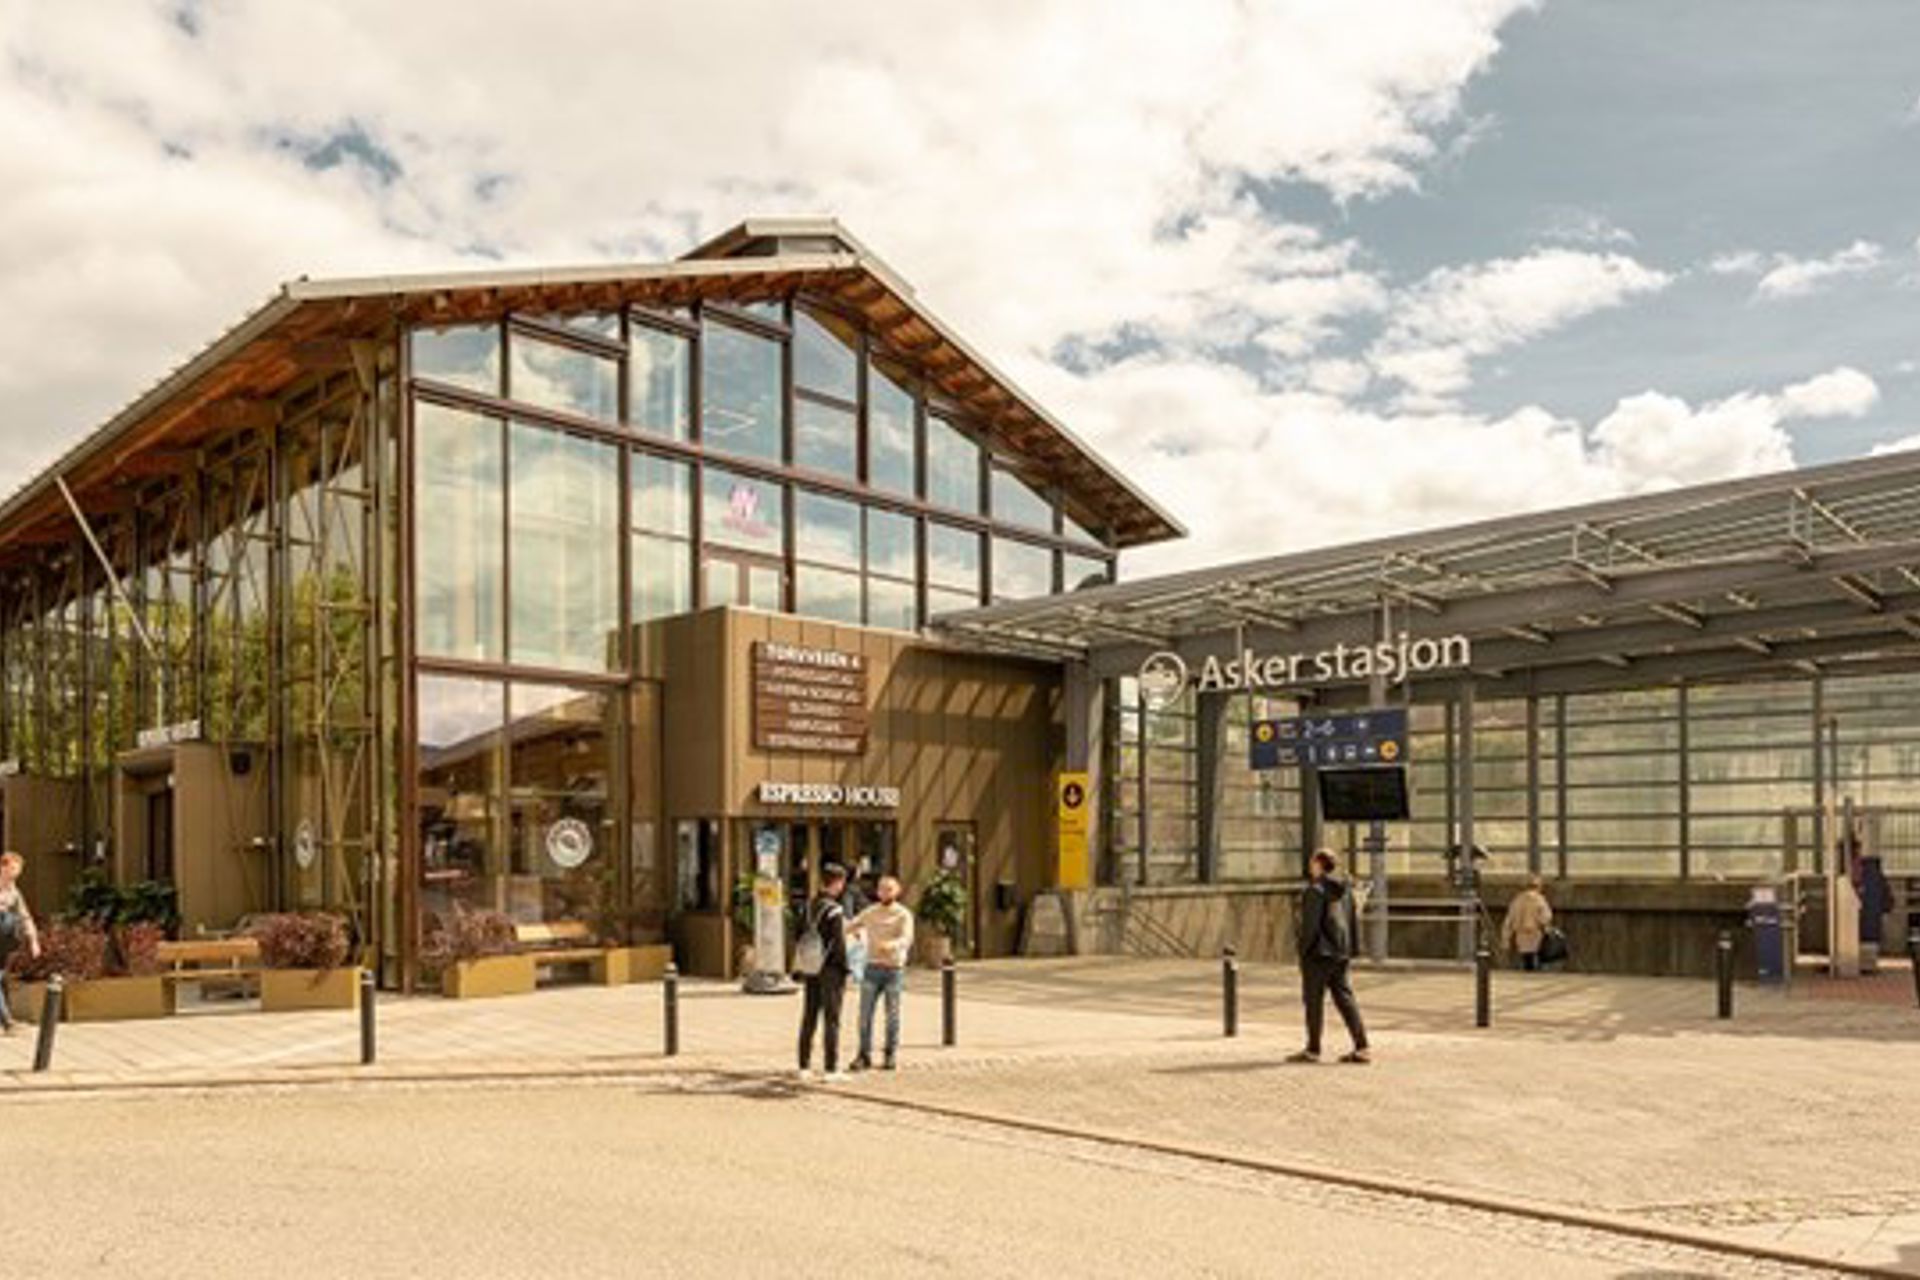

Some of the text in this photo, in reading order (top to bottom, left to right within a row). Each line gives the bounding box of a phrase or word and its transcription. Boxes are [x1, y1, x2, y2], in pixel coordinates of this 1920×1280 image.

[1198, 631, 1470, 691] Asker stasjon
[759, 782, 900, 807] ESPRESSO HOUSE
